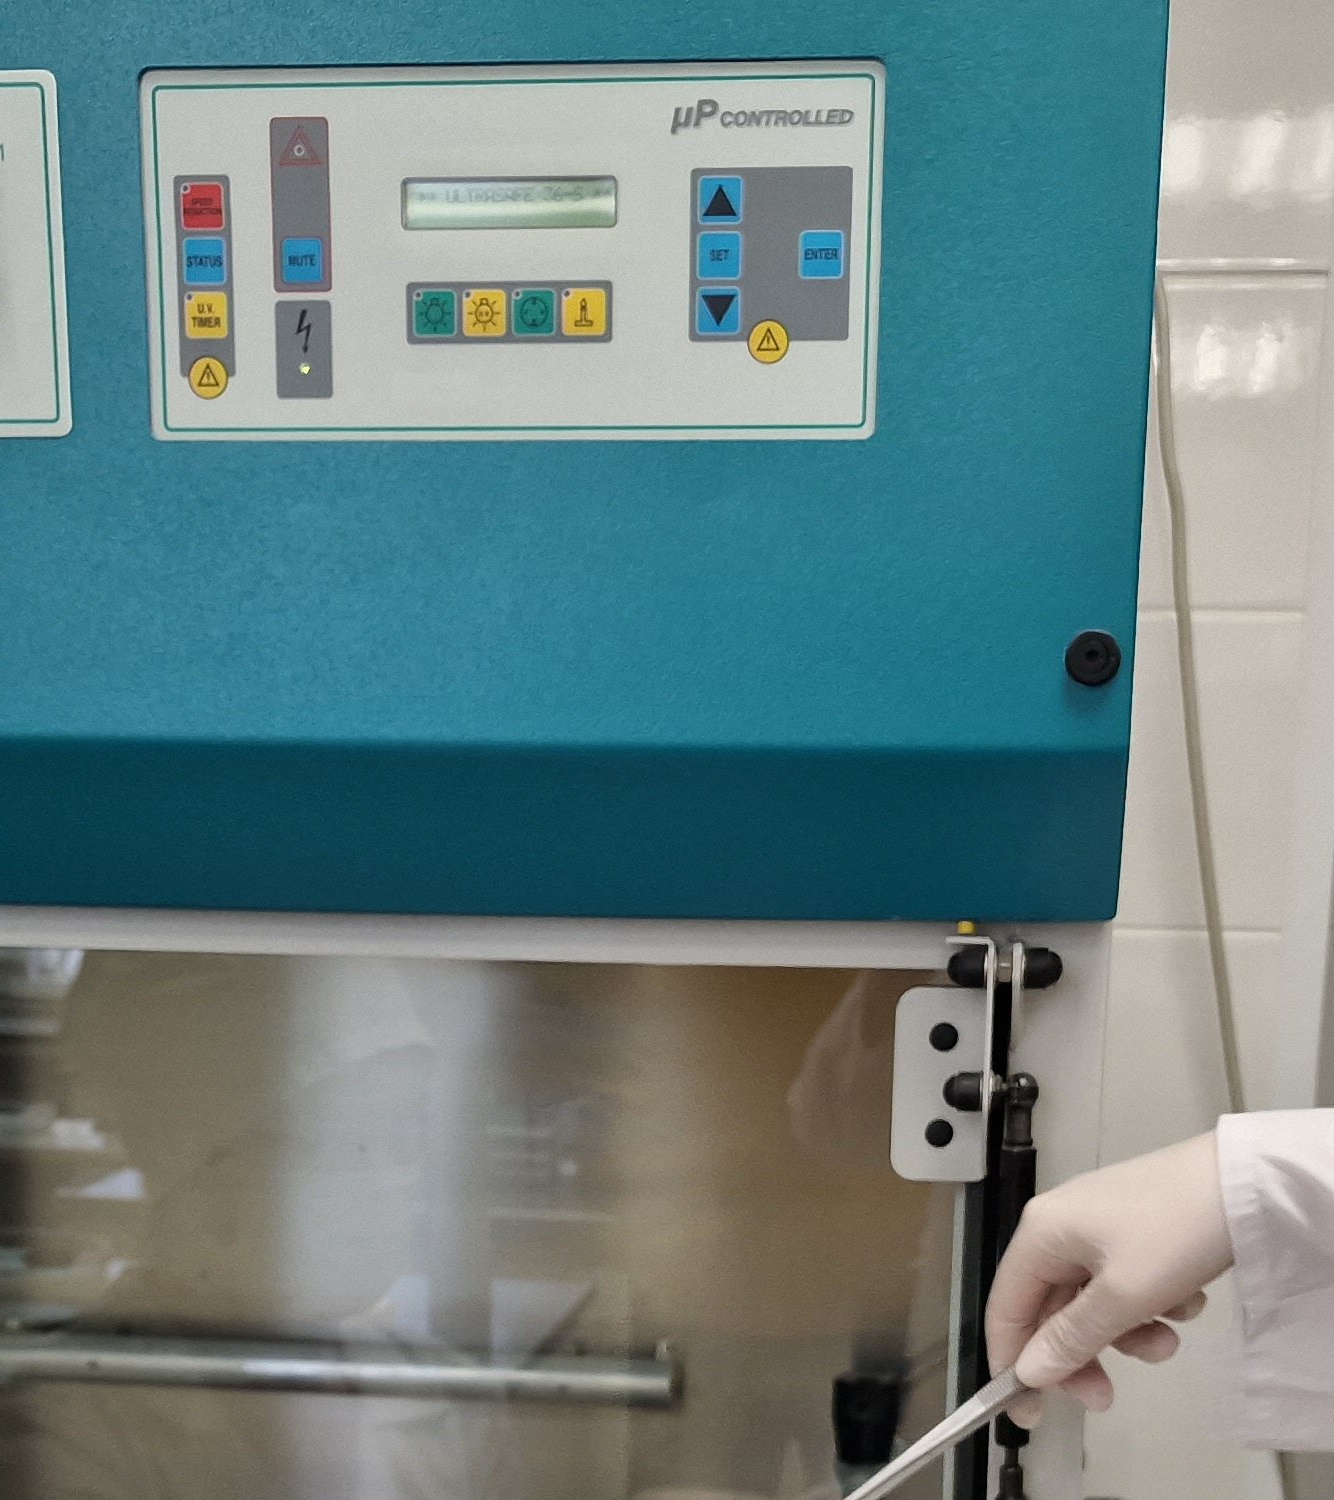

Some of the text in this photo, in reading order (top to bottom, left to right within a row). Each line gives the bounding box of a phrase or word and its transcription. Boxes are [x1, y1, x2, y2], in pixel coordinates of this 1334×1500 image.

[720, 108, 854, 129] CONTROLLED
[288, 254, 316, 267] MUTE
[709, 249, 730, 262] SET
[804, 248, 839, 260] ENTER
[186, 255, 223, 268] STATUS
[191, 316, 221, 329] TIMER
